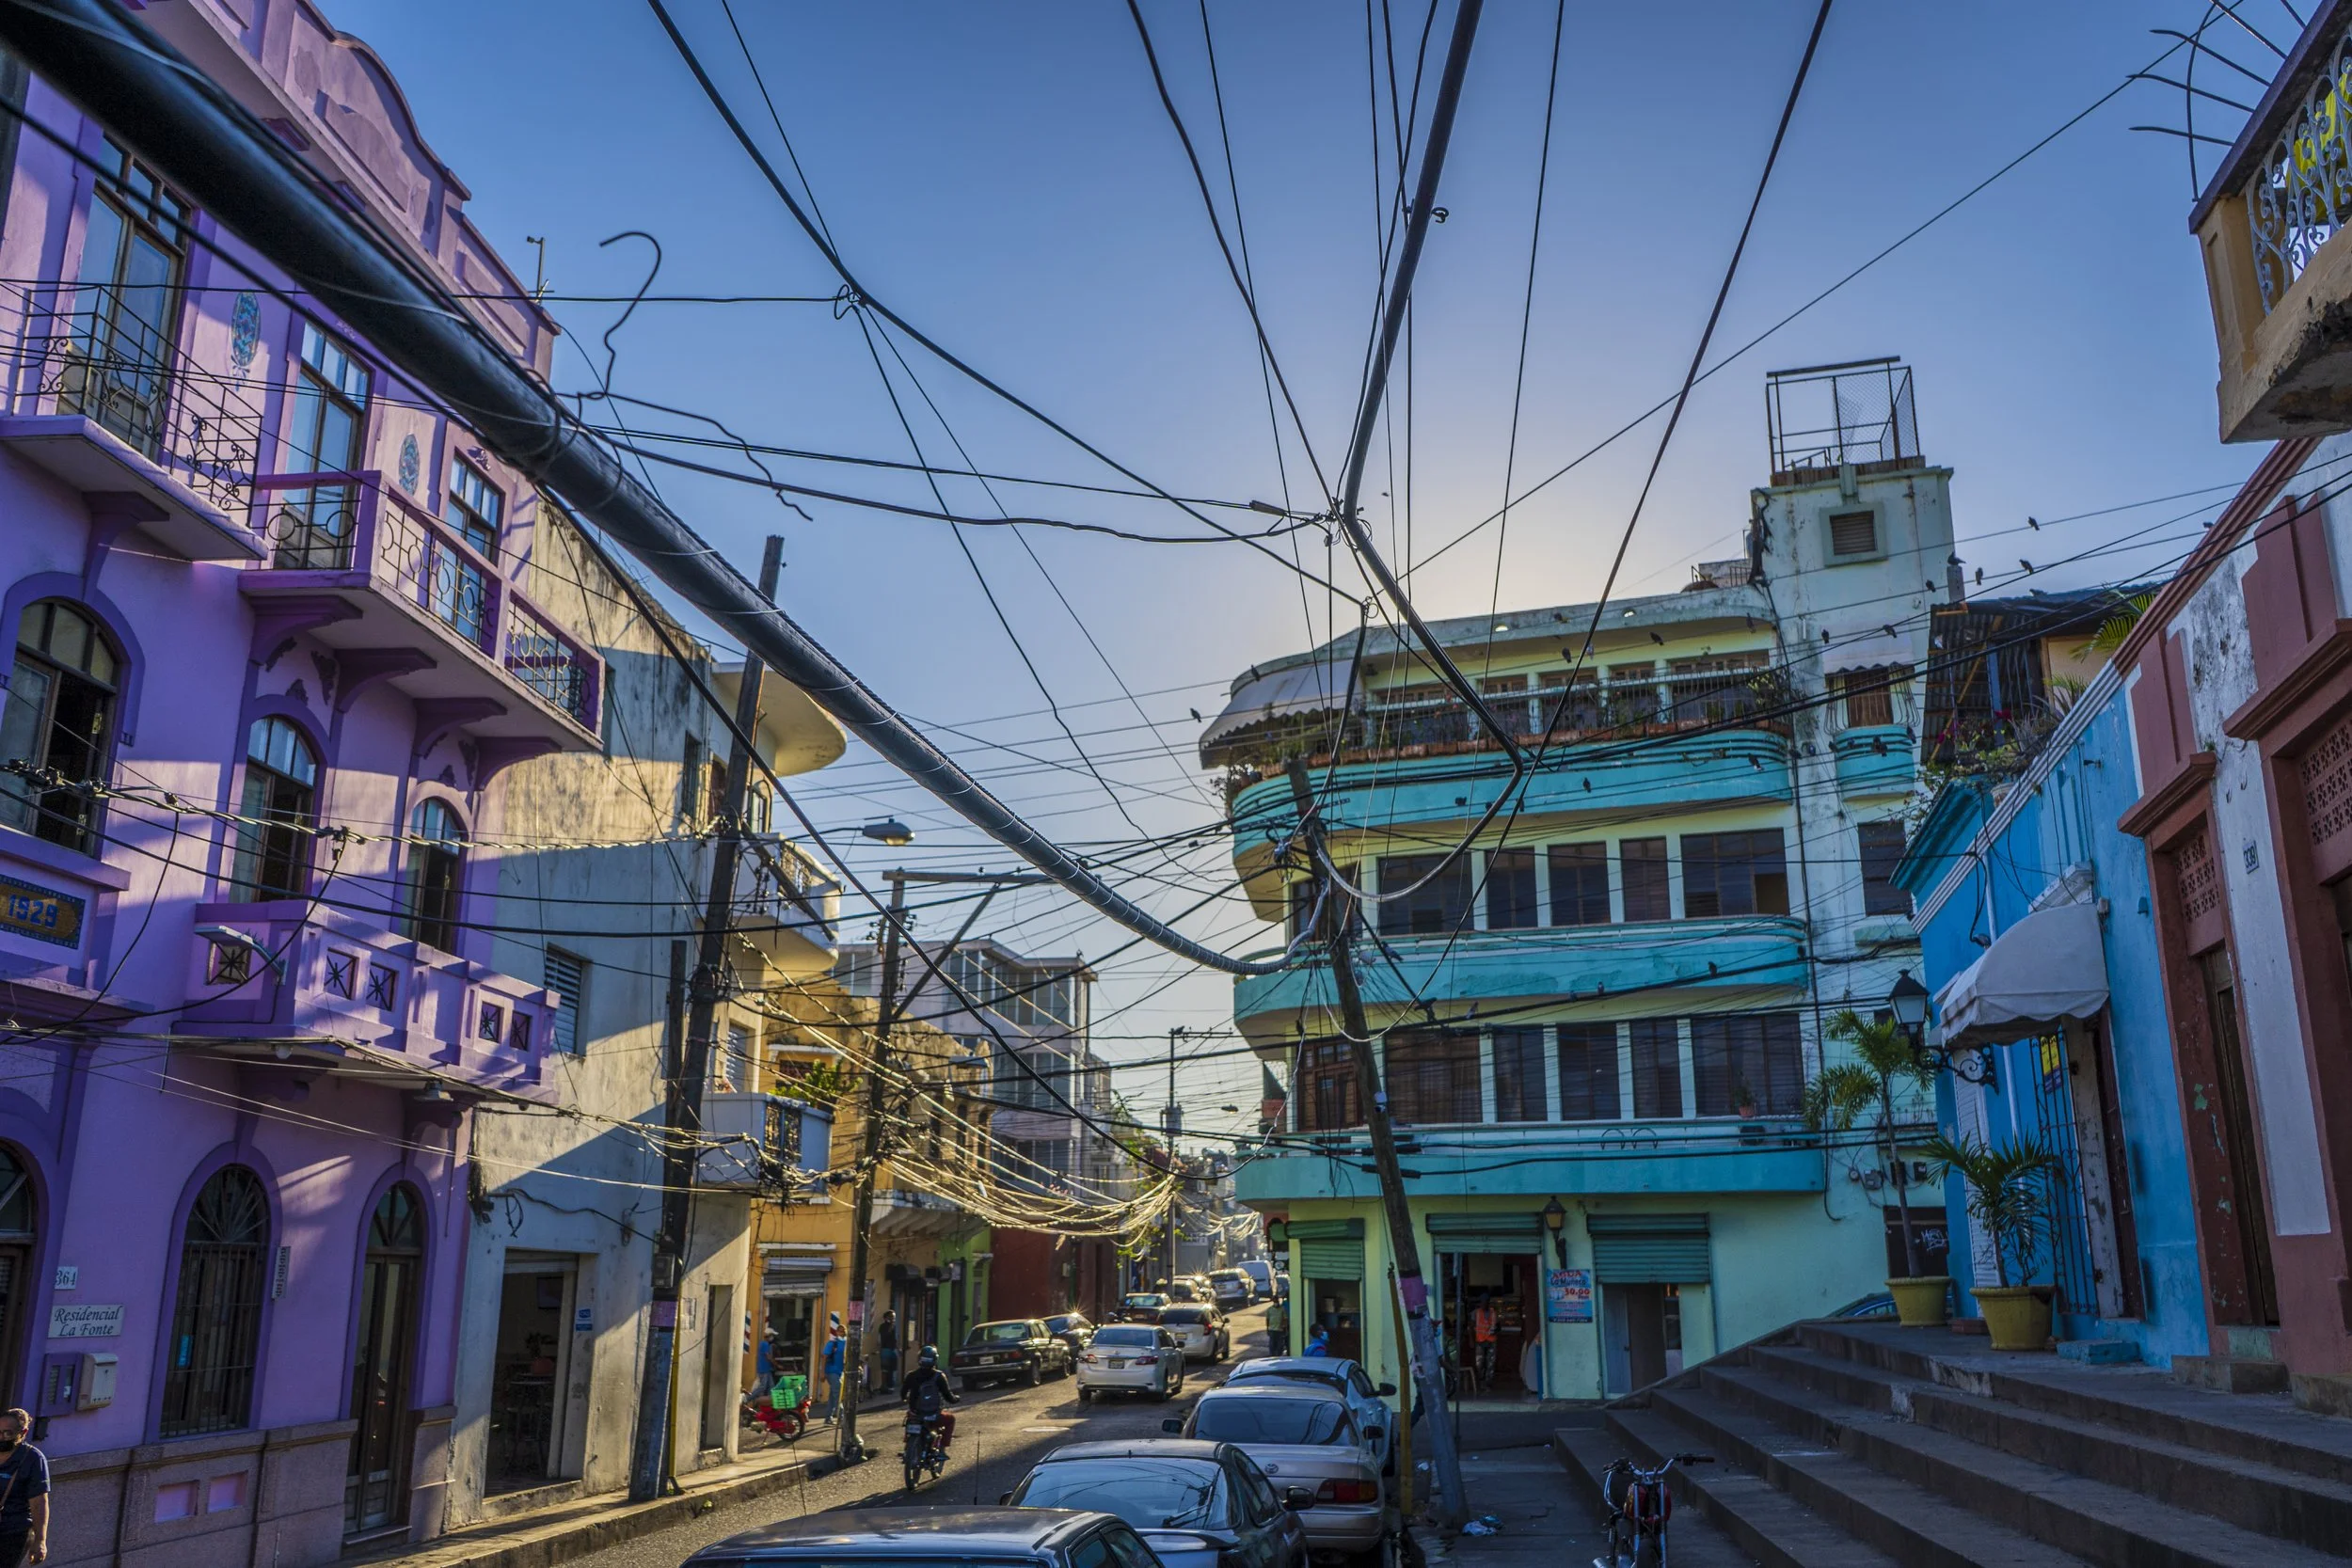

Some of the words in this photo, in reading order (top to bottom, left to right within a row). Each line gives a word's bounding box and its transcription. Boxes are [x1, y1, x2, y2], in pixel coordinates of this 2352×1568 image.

[8, 894, 58, 928] 1929
[56, 1270, 76, 1286] 364
[1552, 1270, 1581, 1279] AGUA
[55, 1306, 123, 1323] Residencial
[59, 1323, 75, 1337] La
[80, 1323, 114, 1336] Fonte
